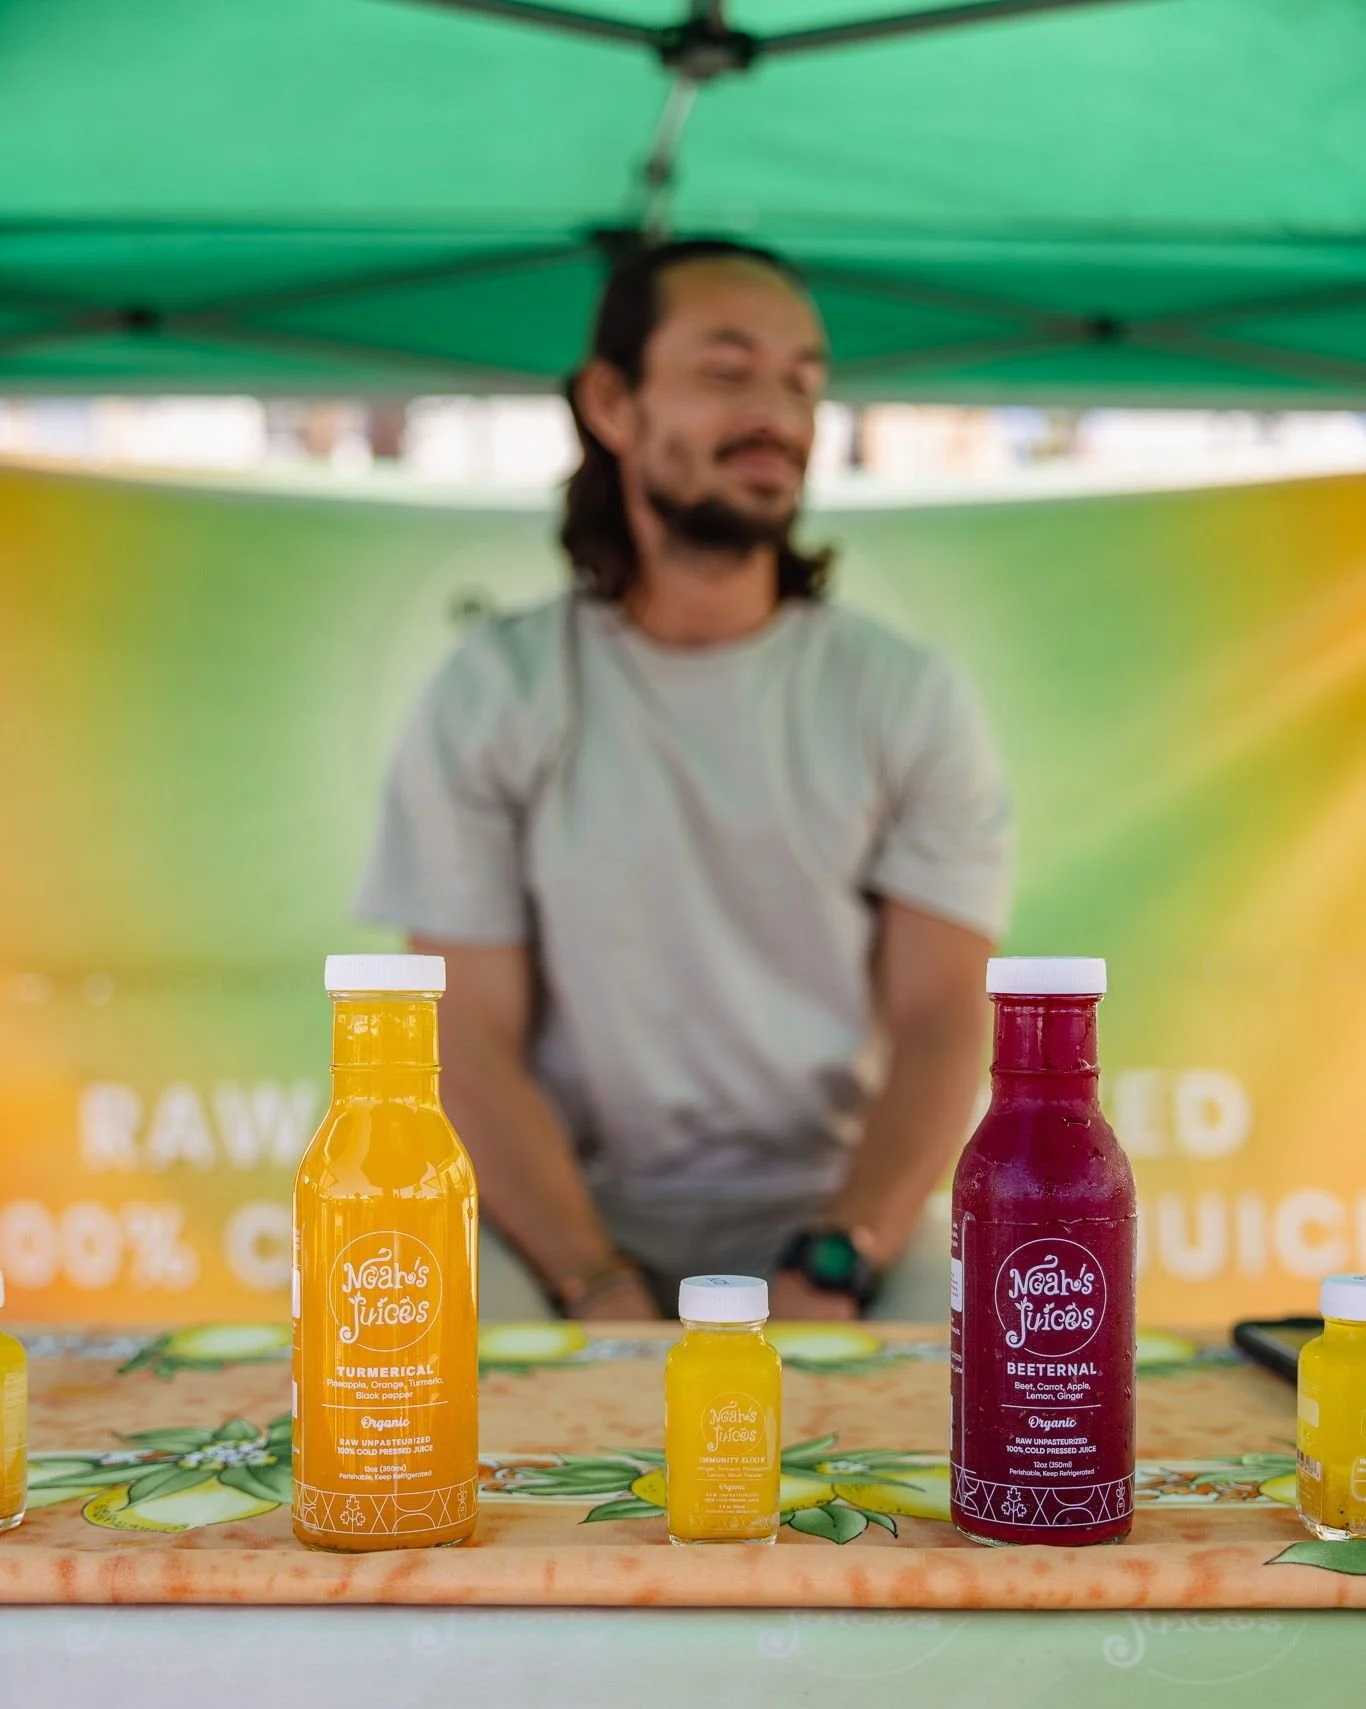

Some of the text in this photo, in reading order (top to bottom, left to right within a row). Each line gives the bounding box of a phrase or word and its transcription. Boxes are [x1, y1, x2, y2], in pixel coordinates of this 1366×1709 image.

[342, 1248, 430, 1293] Noah's
[1008, 1254, 1095, 1298] Noah's
[339, 1291, 430, 1344] Juices
[1005, 1296, 1095, 1348] Juices
[336, 1364, 434, 1378] TURMERICAL
[1007, 1362, 1097, 1376] BEETERNAL
[326, 1378, 369, 1389] Pineapple,
[371, 1380, 407, 1390] Orange,
[1014, 1381, 1091, 1392] Beet, Carrot, Apple,
[356, 1390, 414, 1401] Black pepper
[1026, 1392, 1084, 1401] Lemon, Ginger
[360, 1415, 411, 1432] Organic
[1028, 1416, 1077, 1431] Organic
[339, 1436, 431, 1447] RAW UNPASTEURIZED
[707, 1424, 758, 1452] Juices
[1015, 1437, 1088, 1446] RAW UNPASTEURIZED
[337, 1444, 433, 1457] 100% COLD PRESSED JUICE
[1006, 1445, 1097, 1455] 100% COLD PRESSED JUICE
[699, 1456, 766, 1464] IMMUNITY ELIXIR
[1033, 1461, 1073, 1469] 12oz (350ml)
[374, 1473, 392, 1481] Keep
[1009, 1468, 1095, 1478] Perishable, Keep Refrigerated
